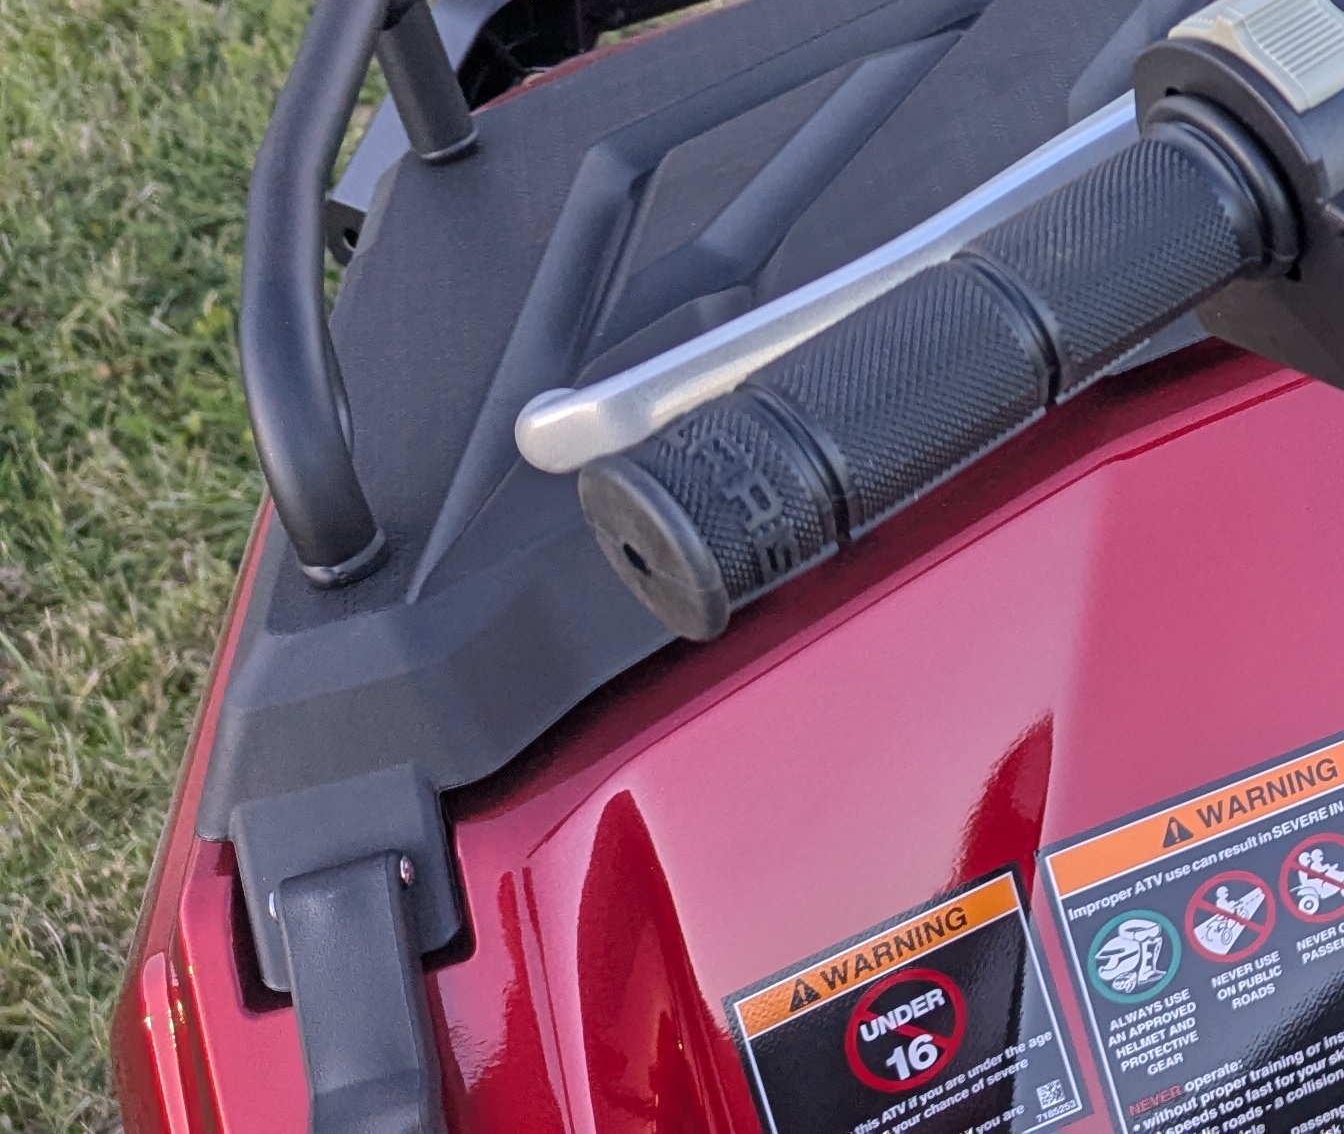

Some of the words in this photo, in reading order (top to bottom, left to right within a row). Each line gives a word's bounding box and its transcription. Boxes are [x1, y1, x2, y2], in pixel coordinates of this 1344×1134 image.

[1196, 758, 1337, 828] WARNING
[1067, 887, 1132, 921] Improper
[1134, 872, 1162, 894] ATV
[1164, 864, 1194, 882] use
[1191, 853, 1217, 871] can
[1218, 836, 1258, 861] result
[1258, 831, 1272, 844] in
[1271, 806, 1328, 838] SEVERE
[820, 906, 967, 990] WARNING
[1296, 926, 1337, 951] NEVER
[1211, 962, 1253, 988] NEVER
[1254, 950, 1280, 969] USE
[1217, 984, 1236, 1000] ON
[1237, 965, 1282, 992] PUBLIC
[860, 988, 945, 1041] UNDER
[1110, 1000, 1163, 1031] ALWAYS
[1164, 988, 1191, 1007] USE
[1231, 982, 1275, 1009] ROADS
[1108, 1030, 1126, 1047] AN
[1129, 1001, 1196, 1038] APPROVED
[1115, 1028, 1166, 1059] HELMET
[1169, 1017, 1195, 1036] AND
[886, 1033, 938, 1080] 16
[1120, 1030, 1199, 1072] PROTECTIVE
[1147, 1052, 1183, 1075] GEAR
[854, 1118, 880, 1134] this
[881, 1101, 906, 1124] ATV
[907, 1095, 918, 1109] if
[918, 1084, 944, 1106] you
[944, 1073, 966, 1091] are
[967, 1053, 1003, 1078] under
[1004, 1042, 1026, 1058] the
[1028, 1031, 1052, 1048] age
[891, 1112, 921, 1134] your
[923, 1088, 969, 1118] chance
[971, 1077, 984, 1093] of
[986, 1058, 1029, 1085] severe
